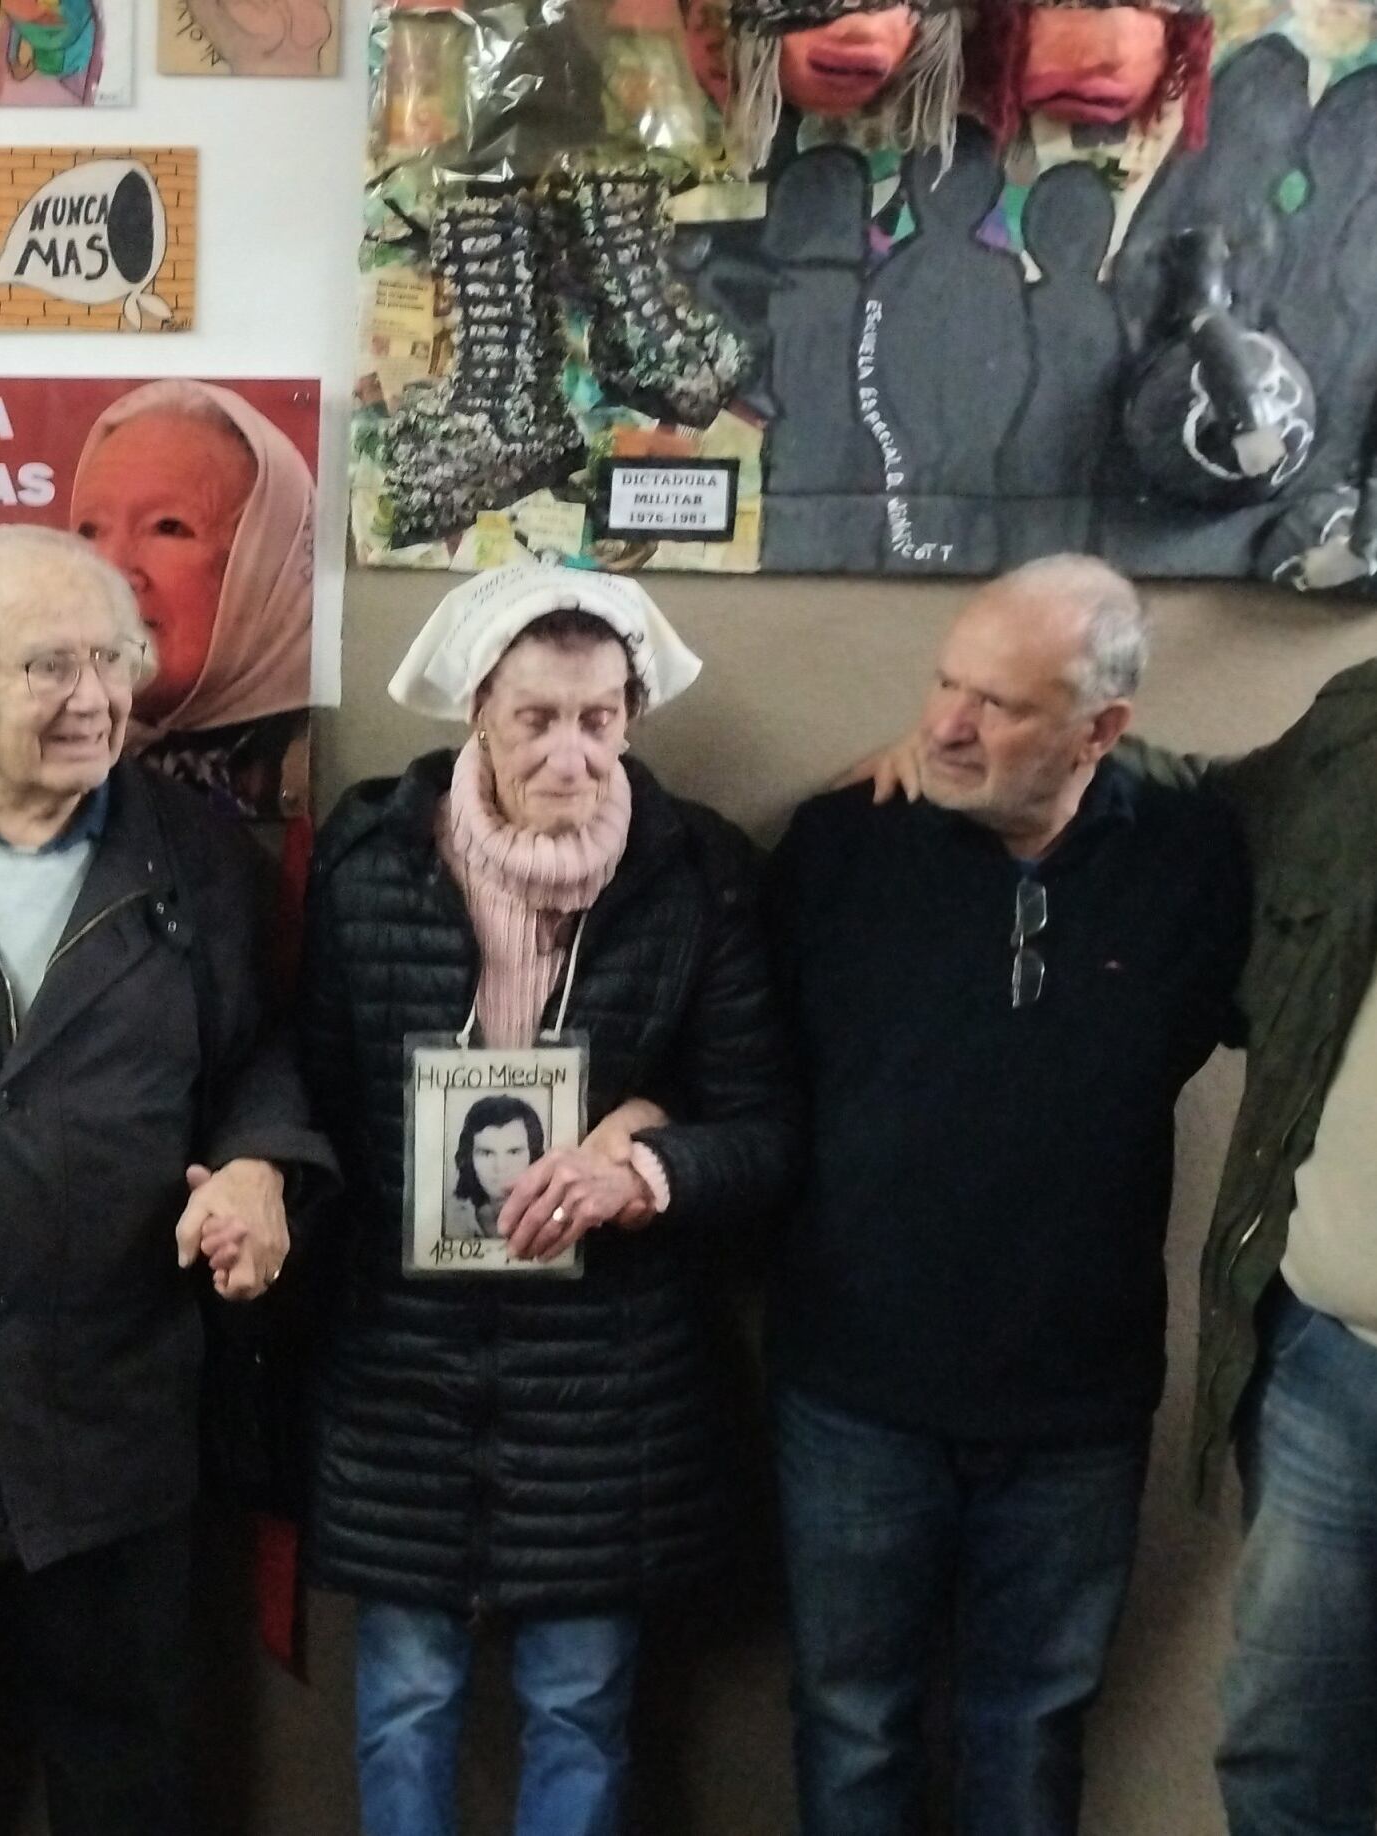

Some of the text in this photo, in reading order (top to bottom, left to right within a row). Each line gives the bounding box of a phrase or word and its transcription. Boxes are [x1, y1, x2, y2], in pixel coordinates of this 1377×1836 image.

[28, 193, 108, 233] NUNCA
[14, 233, 109, 281] MAS
[622, 473, 718, 487] DICTADURA
[633, 493, 704, 506] MILITAR
[417, 1063, 482, 1091] HUGO
